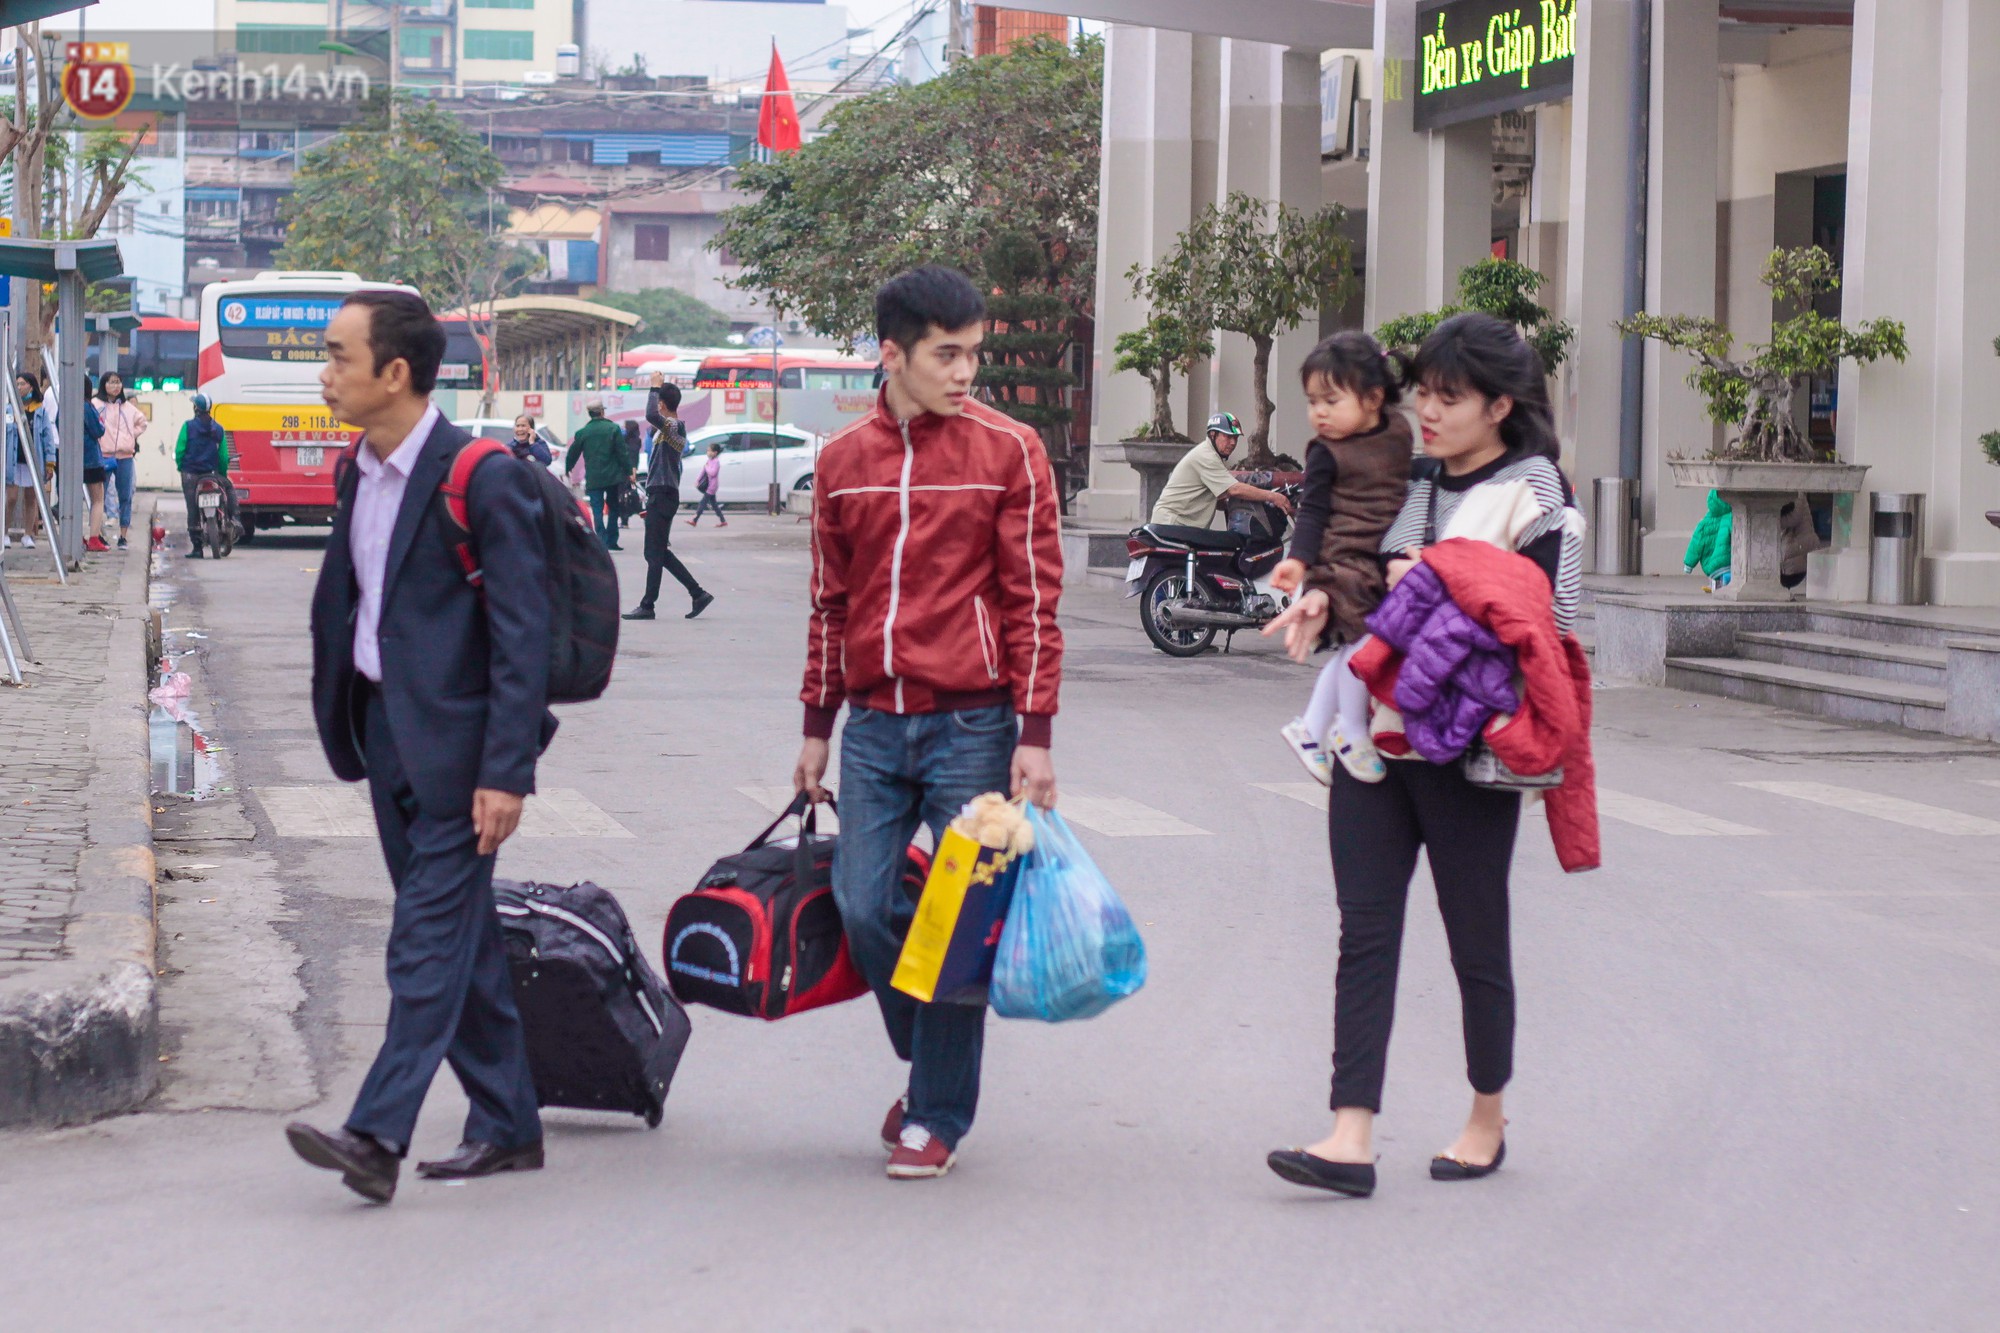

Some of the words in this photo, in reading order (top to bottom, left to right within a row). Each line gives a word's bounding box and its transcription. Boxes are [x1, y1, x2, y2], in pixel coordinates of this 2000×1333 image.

[1421, 12, 1457, 95] Bến
[1460, 40, 1482, 85] xe
[1486, 9, 1535, 89] Giáp
[227, 306, 243, 320] 42
[267, 327, 317, 345] BẮC
[281, 416, 299, 429] 29B
[310, 416, 340, 429] 116.83
[272, 432, 350, 441] DAEWOO
